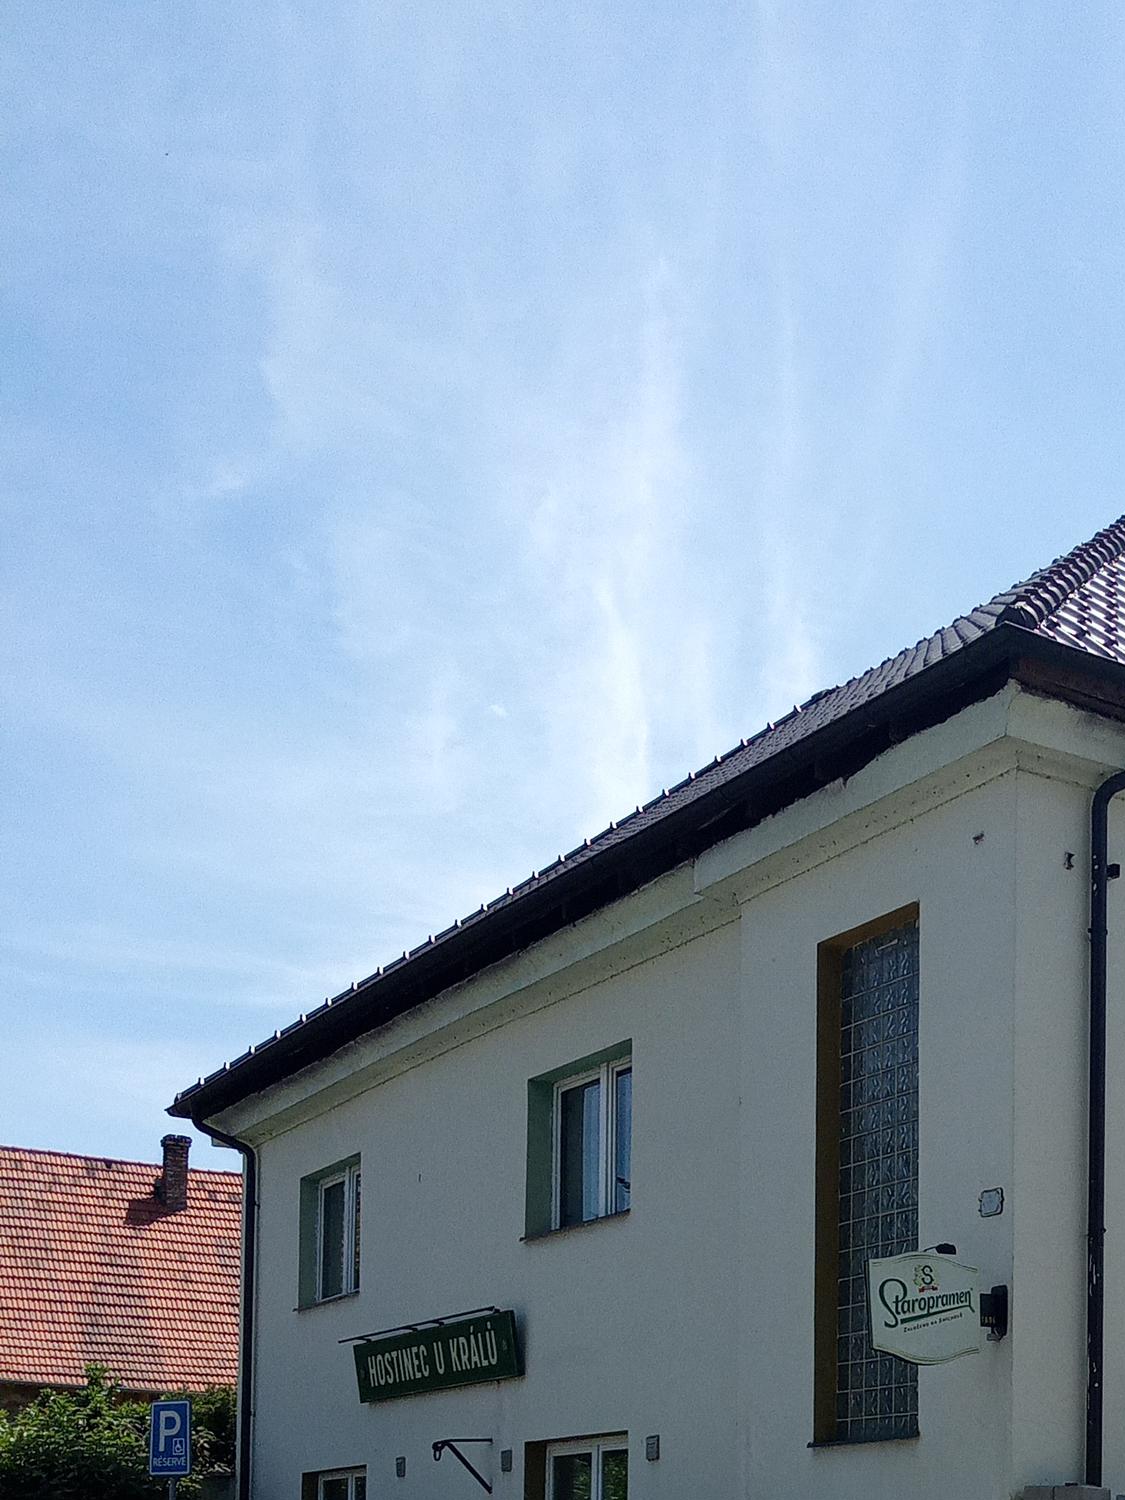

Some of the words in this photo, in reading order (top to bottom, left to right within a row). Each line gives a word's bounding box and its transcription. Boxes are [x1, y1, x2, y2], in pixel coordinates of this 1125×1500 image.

[879, 1278, 975, 1328] Staropramen
[367, 1345, 430, 1387] HOSTINEC
[433, 1341, 445, 1375] U
[449, 1322, 498, 1372] KRÁLŮ
[159, 1411, 181, 1452] P
